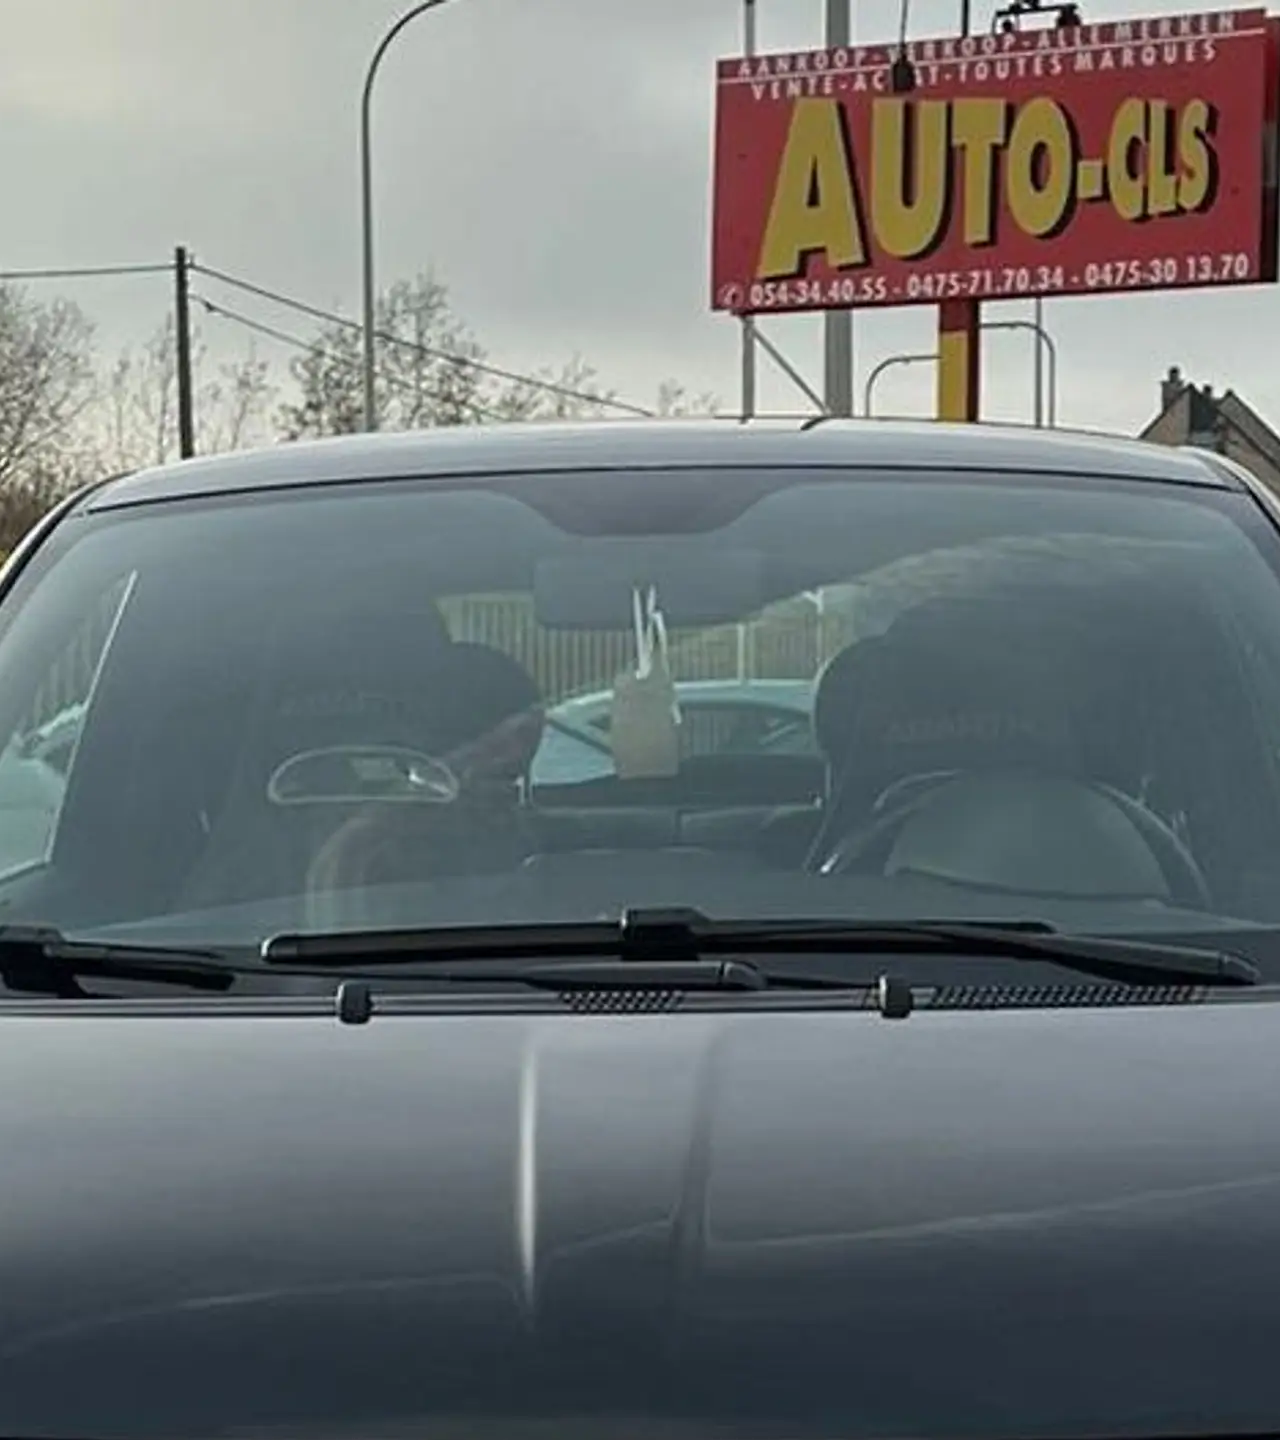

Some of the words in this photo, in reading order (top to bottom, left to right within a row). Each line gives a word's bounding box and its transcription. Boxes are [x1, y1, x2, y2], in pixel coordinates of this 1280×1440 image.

[1115, 13, 1236, 41] MERKEN
[1073, 40, 1216, 71] MARQUES
[756, 97, 1212, 277] AUTO-CLS
[906, 265, 1064, 298] 0475-71.70.34
